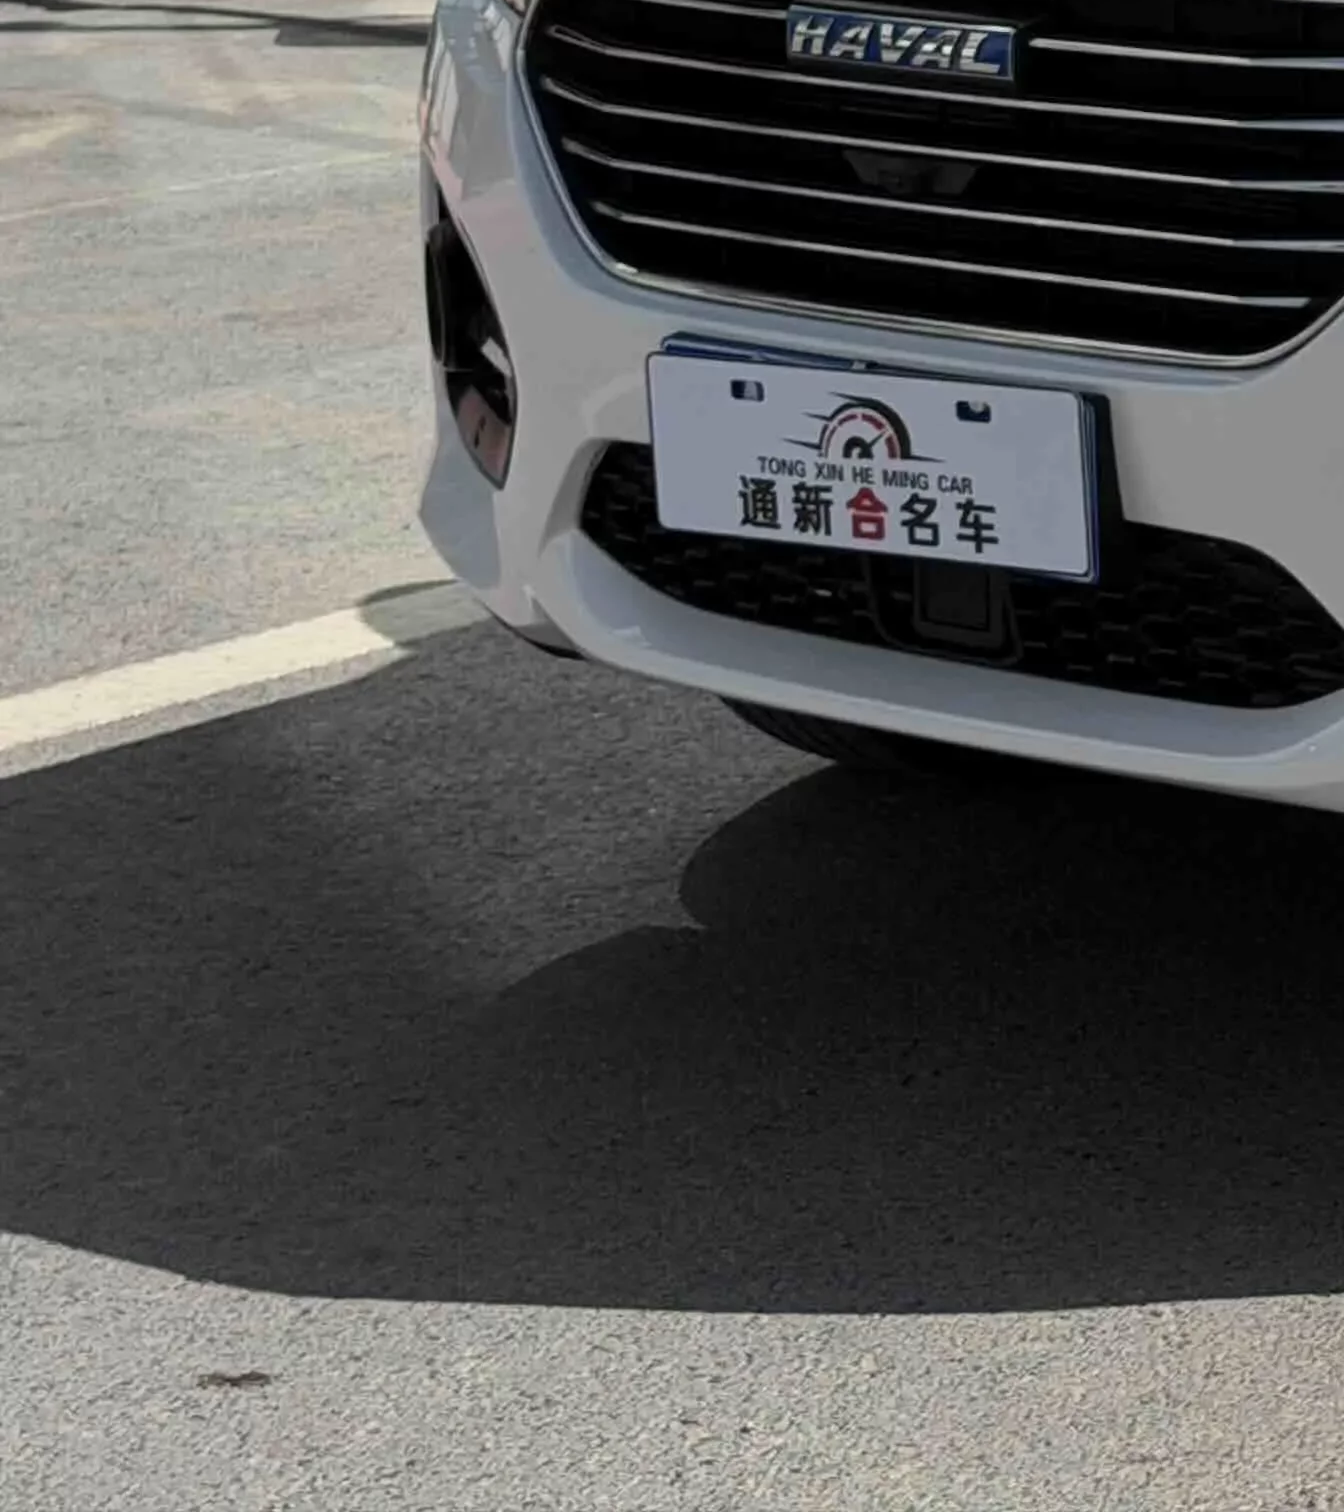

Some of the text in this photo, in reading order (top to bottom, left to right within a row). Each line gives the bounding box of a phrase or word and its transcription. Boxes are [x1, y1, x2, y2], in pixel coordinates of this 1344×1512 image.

[790, 14, 1001, 74] HAVAL
[757, 456, 974, 496] TONG XIN HE MING CAR
[739, 475, 1000, 554] 通新合名车
